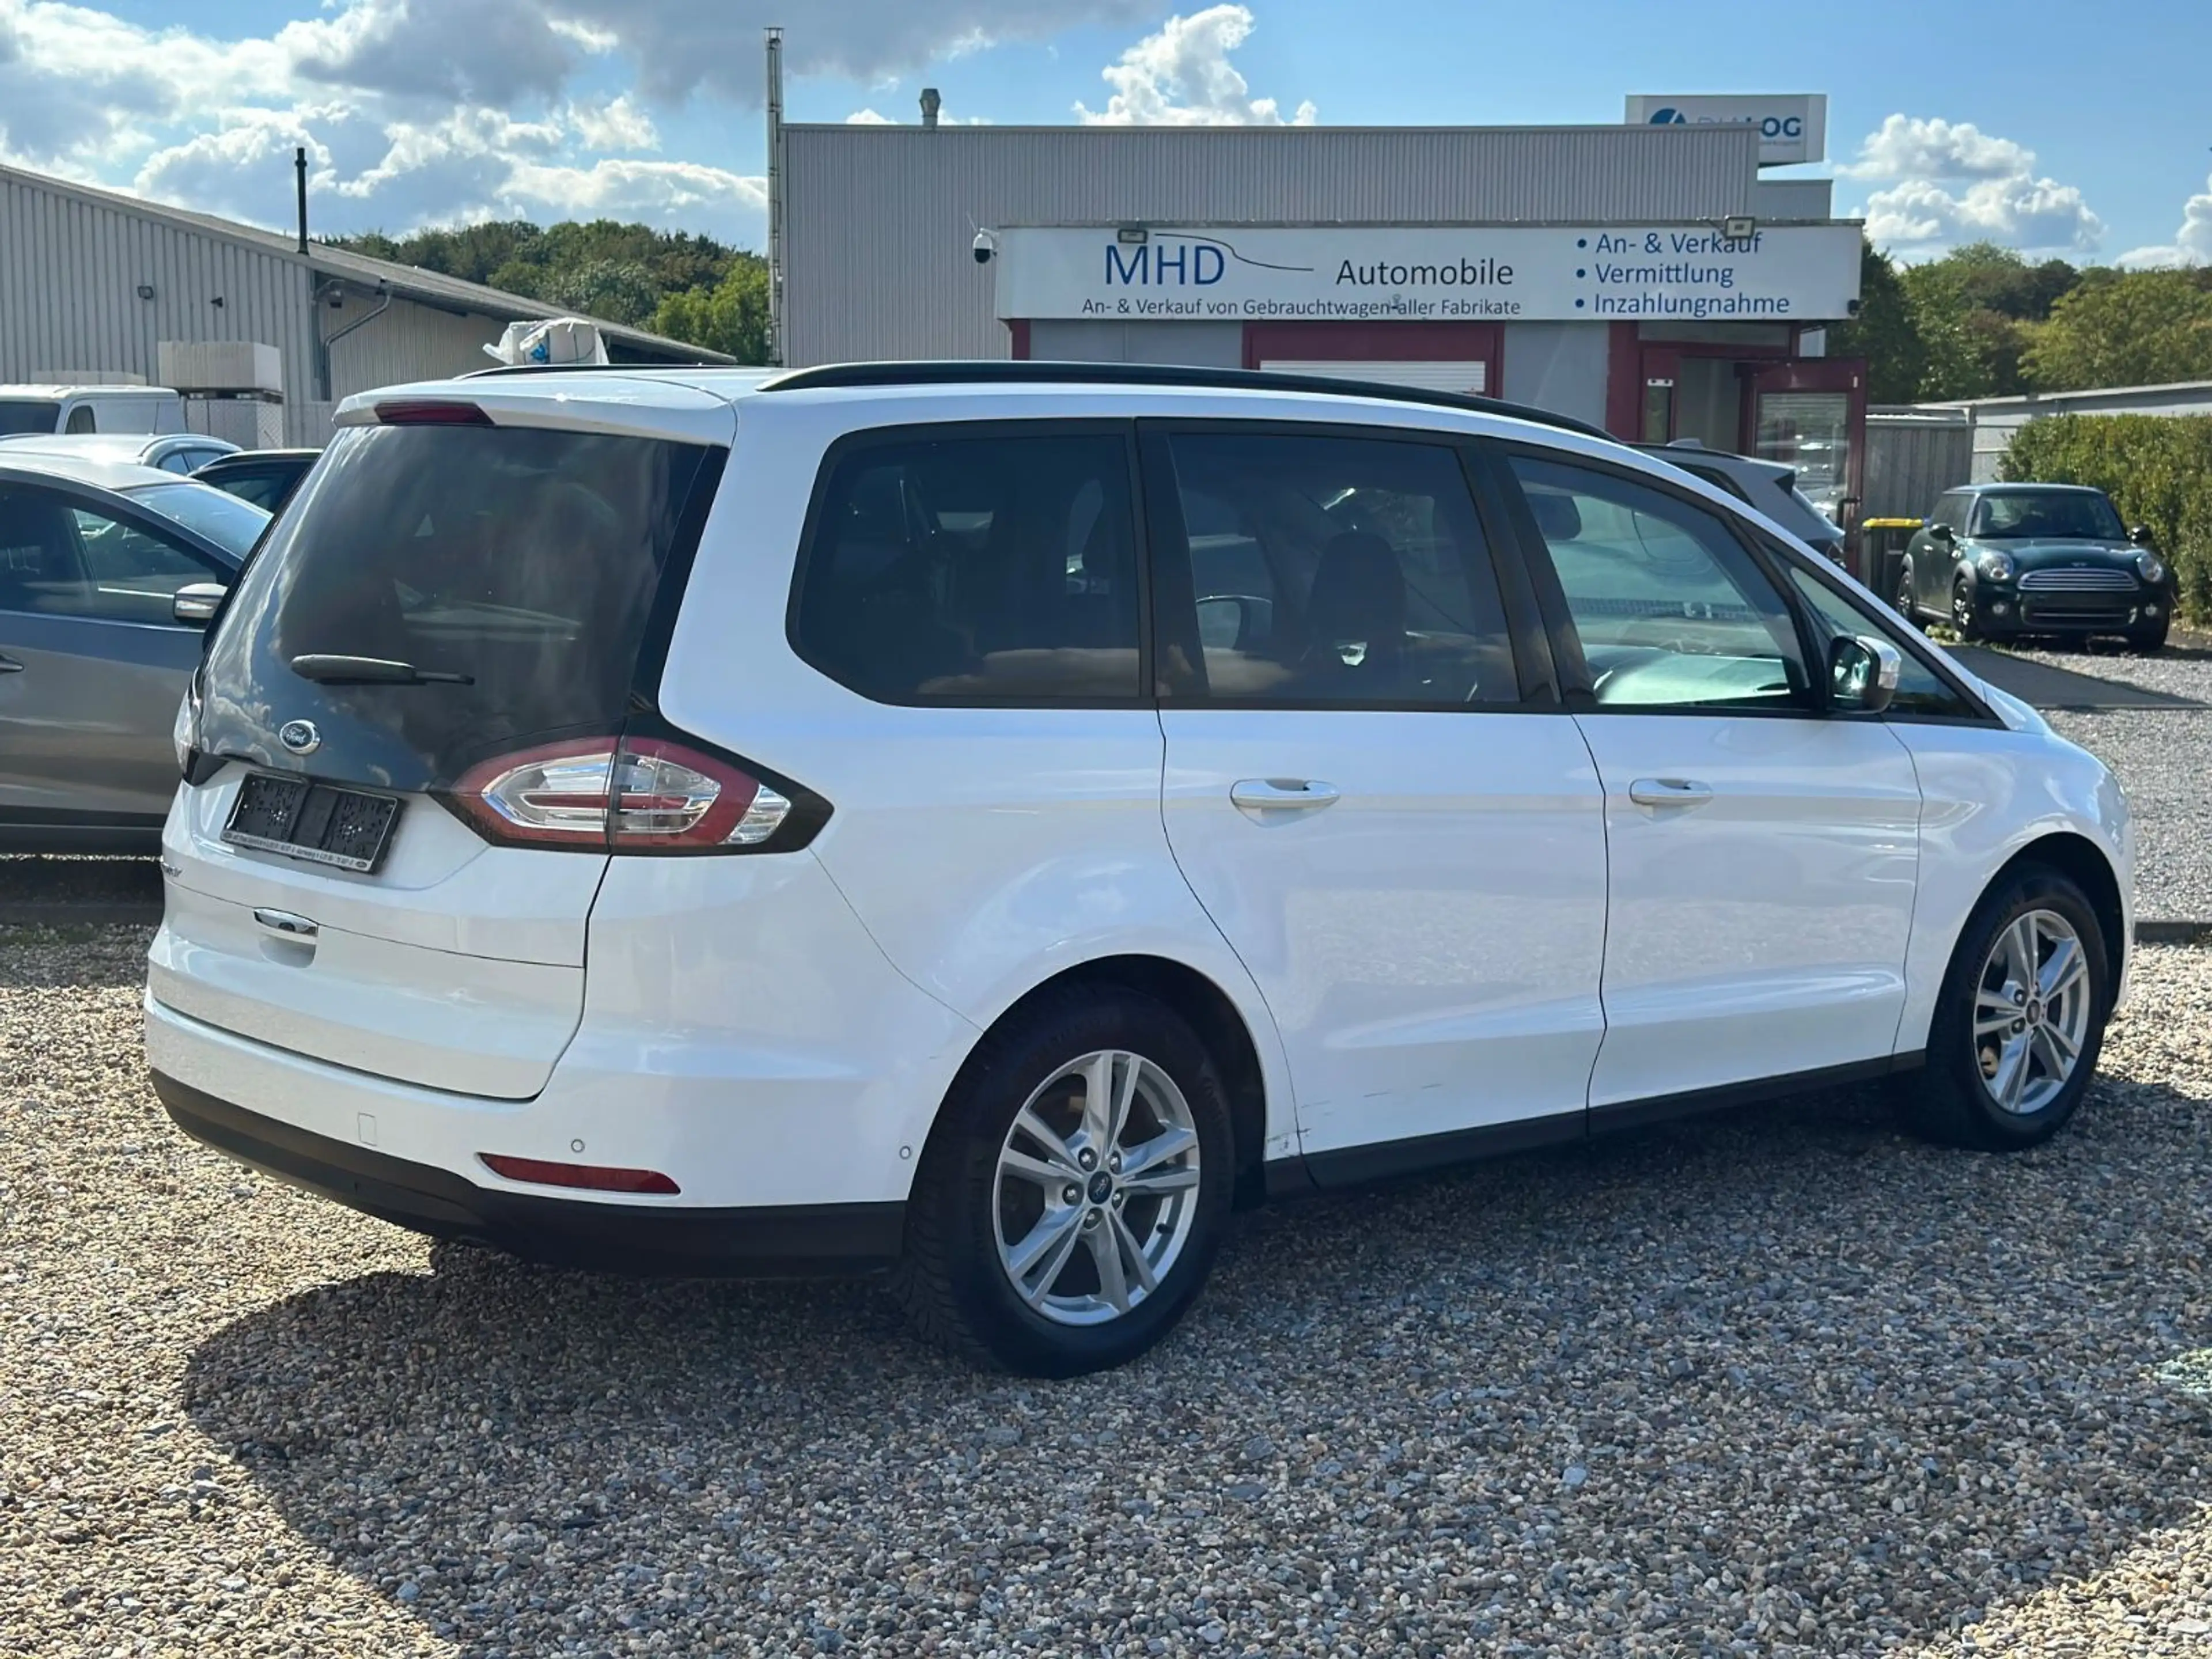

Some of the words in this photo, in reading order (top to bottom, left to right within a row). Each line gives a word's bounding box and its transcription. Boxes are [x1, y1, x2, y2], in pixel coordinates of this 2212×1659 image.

[1596, 233, 1637, 254] An-
[1645, 233, 1662, 254] &
[1671, 232, 1763, 253] Verkauf
[1105, 245, 1225, 285] MHD
[1335, 257, 1514, 286] Automobile
[1595, 262, 1734, 288] Vermittlung
[1082, 298, 1112, 314] An-
[1117, 298, 1131, 314] &
[1136, 298, 1202, 315] Verkauf
[1207, 302, 1238, 315] von
[1243, 298, 1389, 317] Gebrauchtwagen
[1398, 298, 1435, 315] aller
[1442, 298, 1521, 315] Fabrikate
[1594, 292, 1790, 319] Inzahlungnahme
